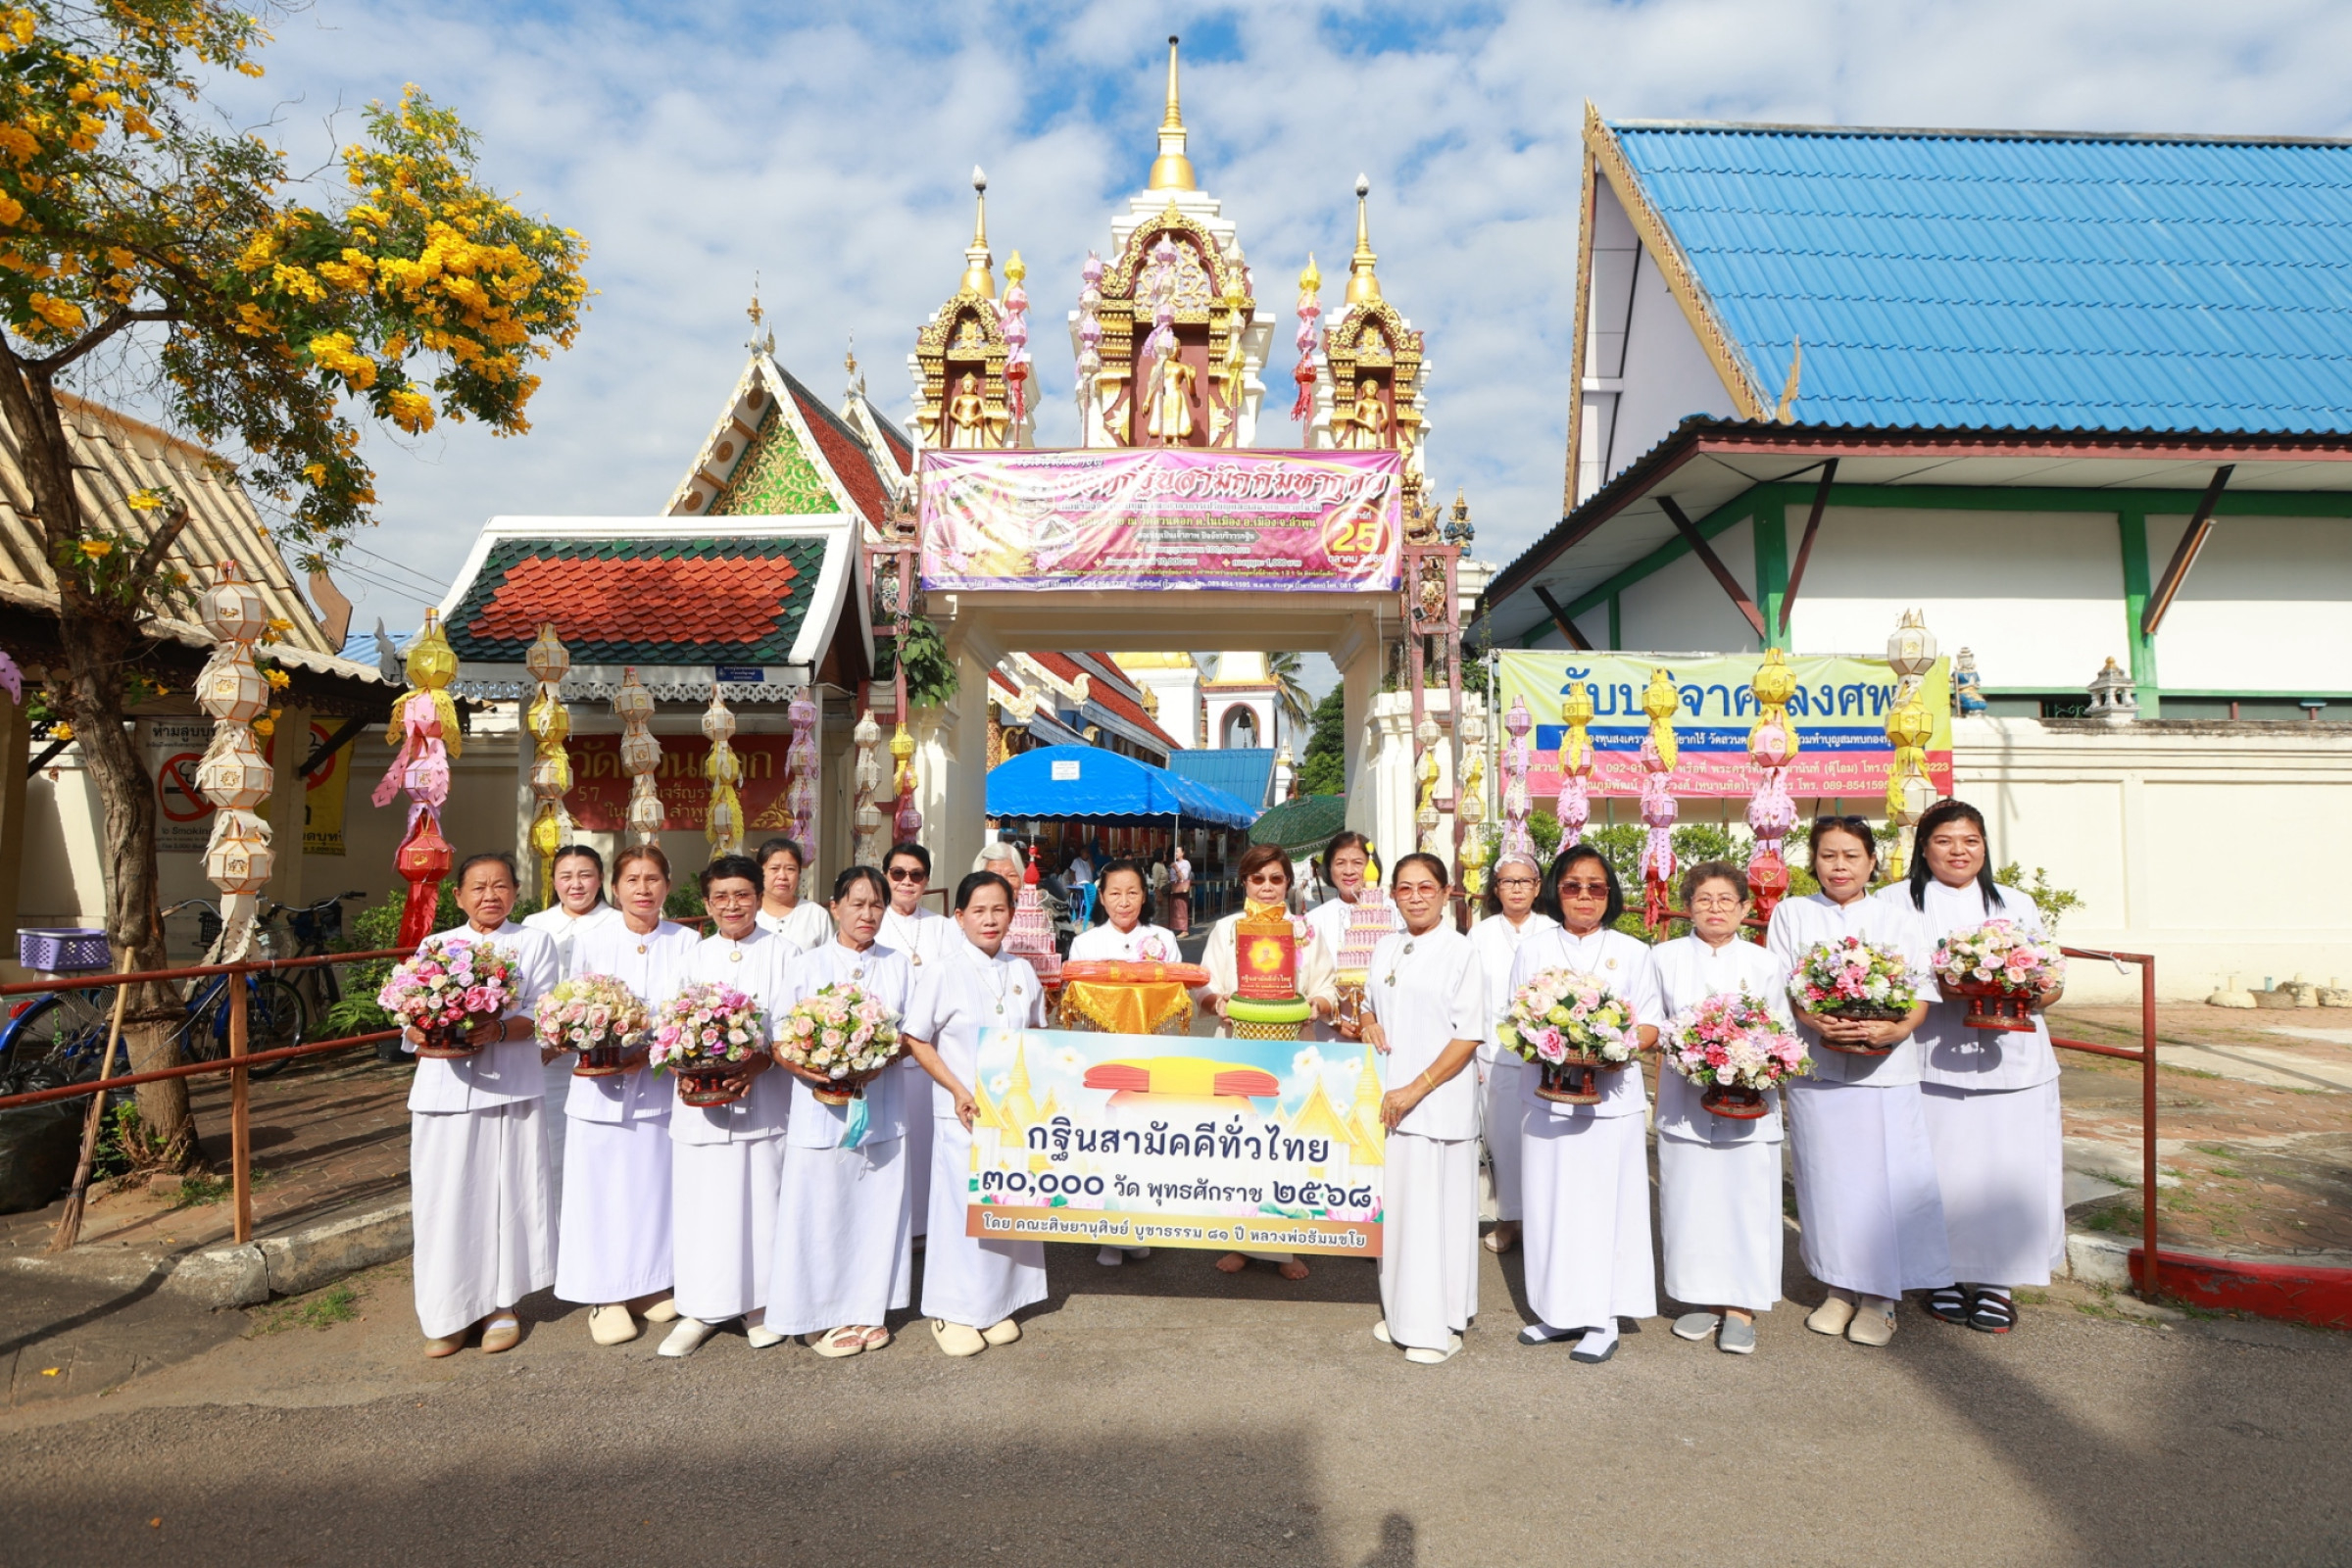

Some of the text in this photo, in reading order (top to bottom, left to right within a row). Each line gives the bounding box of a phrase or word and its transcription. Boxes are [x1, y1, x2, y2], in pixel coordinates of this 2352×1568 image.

[1140, 514, 1193, 526] วัดสวนดอก
[1243, 514, 1277, 528] อ.เมือง
[1279, 515, 1317, 530] จ.ลำพูน
[1333, 522, 1379, 553] 25
[578, 785, 600, 802] 57
[1796, 777, 1819, 791] โทร.
[172, 826, 213, 835] Smokin
[1028, 1114, 1329, 1163] กฐินสามัคคีทั่วไทย
[982, 1169, 1372, 1208] ๓๐,๐๐๐ วัด พุทธศักราช ๒๕๖๘
[983, 1213, 1367, 1247] โดย คณะศิษยานุศิษย์ บูชาธรรม ๘๑ ปี หลวงพ่อธัมมชโย
